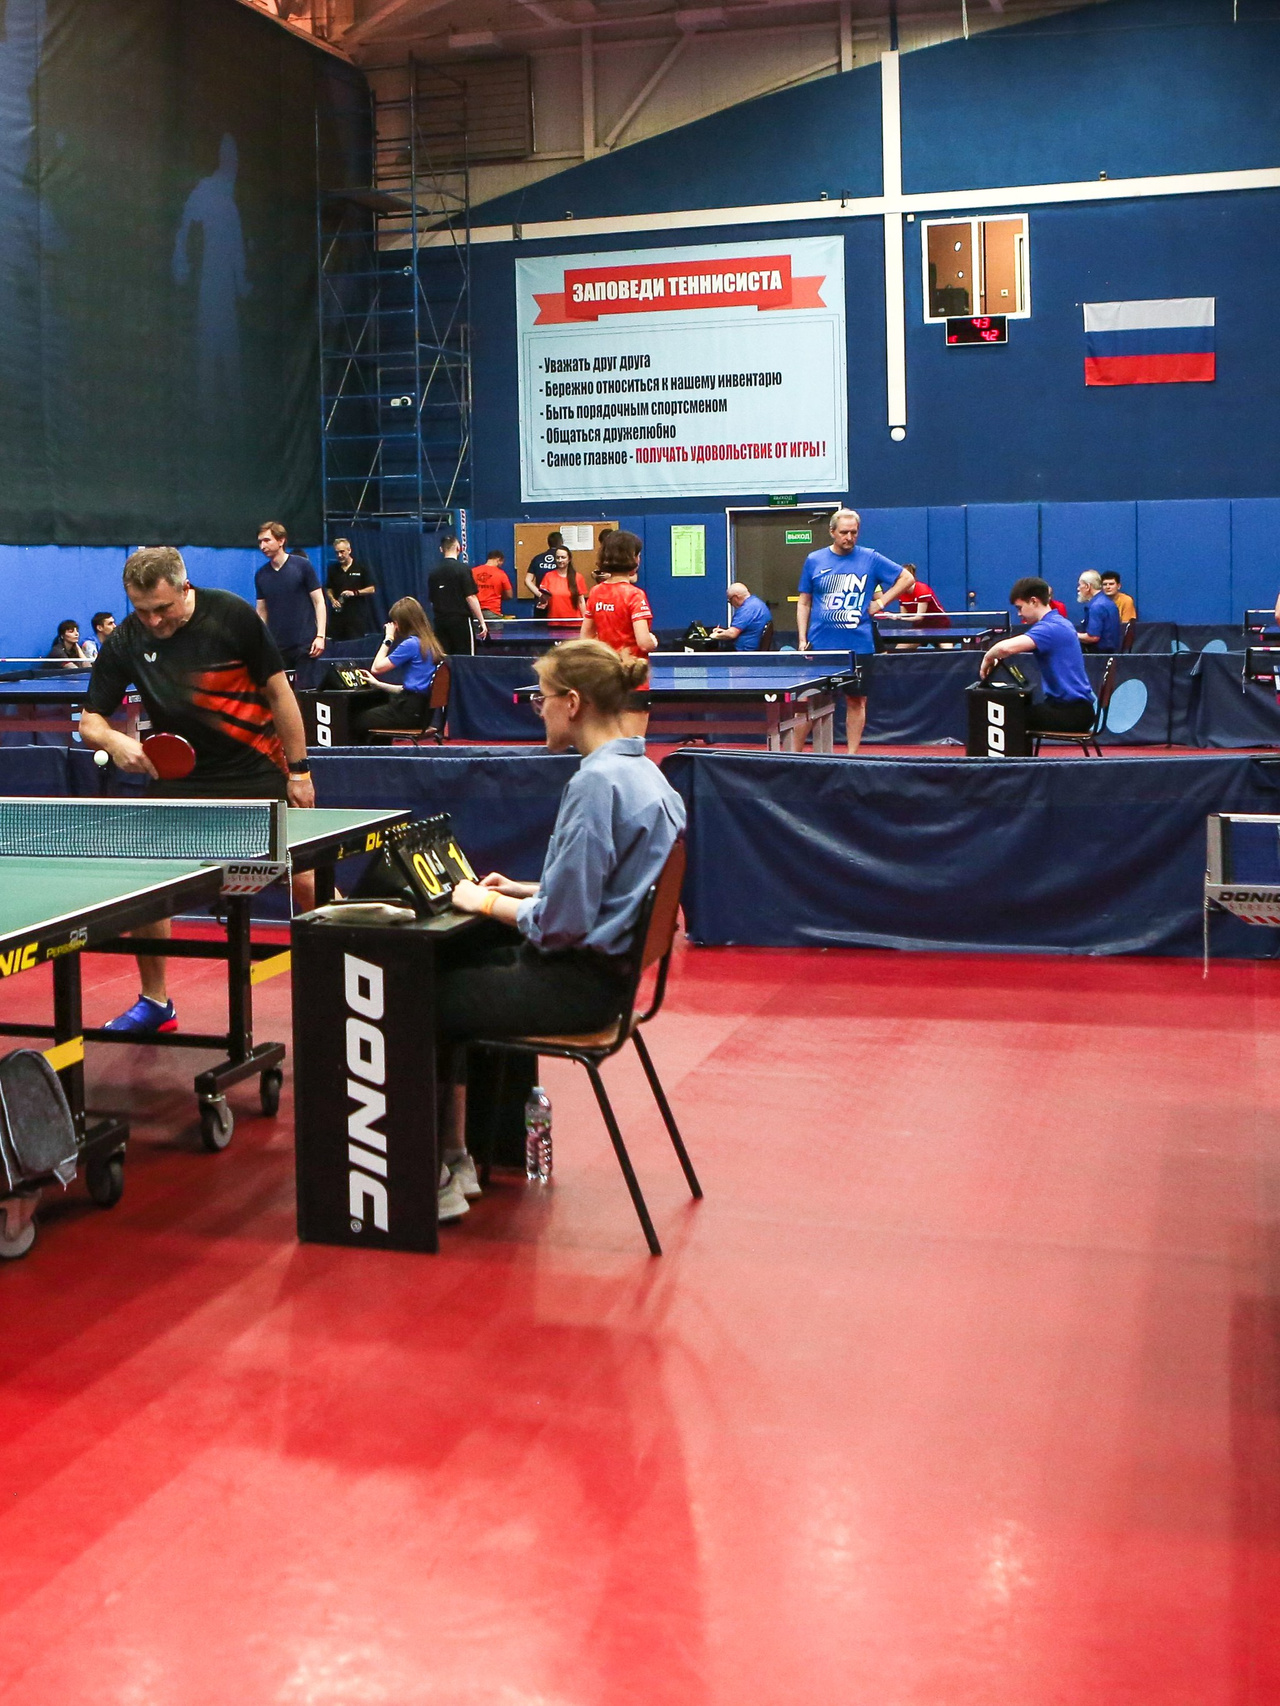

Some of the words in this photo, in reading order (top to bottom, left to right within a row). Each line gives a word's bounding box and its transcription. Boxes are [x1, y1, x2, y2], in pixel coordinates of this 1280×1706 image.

[572, 277, 665, 302] ЗАПОВЕДИ
[667, 270, 783, 297] ТЕННИСИСТА
[544, 357, 591, 373] Уважать
[593, 356, 618, 373] друг
[620, 354, 651, 371] друга
[545, 381, 594, 398] Бережно
[596, 378, 660, 394] относиться
[661, 377, 669, 391] к
[670, 375, 716, 390] нашему
[718, 371, 782, 388] инвентарю
[545, 404, 575, 420] Быть
[576, 402, 649, 419] порядочным
[651, 398, 728, 416] спортсменом
[546, 427, 601, 445] Общаться
[602, 422, 677, 443] дружелюбно
[546, 451, 582, 468] Самое
[583, 450, 628, 466] главное
[635, 446, 689, 464] ПОЛУЧАТЬ
[690, 442, 773, 464] УДОВОЛЬСТВИЕ
[775, 442, 788, 459] ОТ
[228, 865, 279, 875] DONIC
[413, 853, 441, 896] 0
[343, 952, 390, 1233] DONIC
